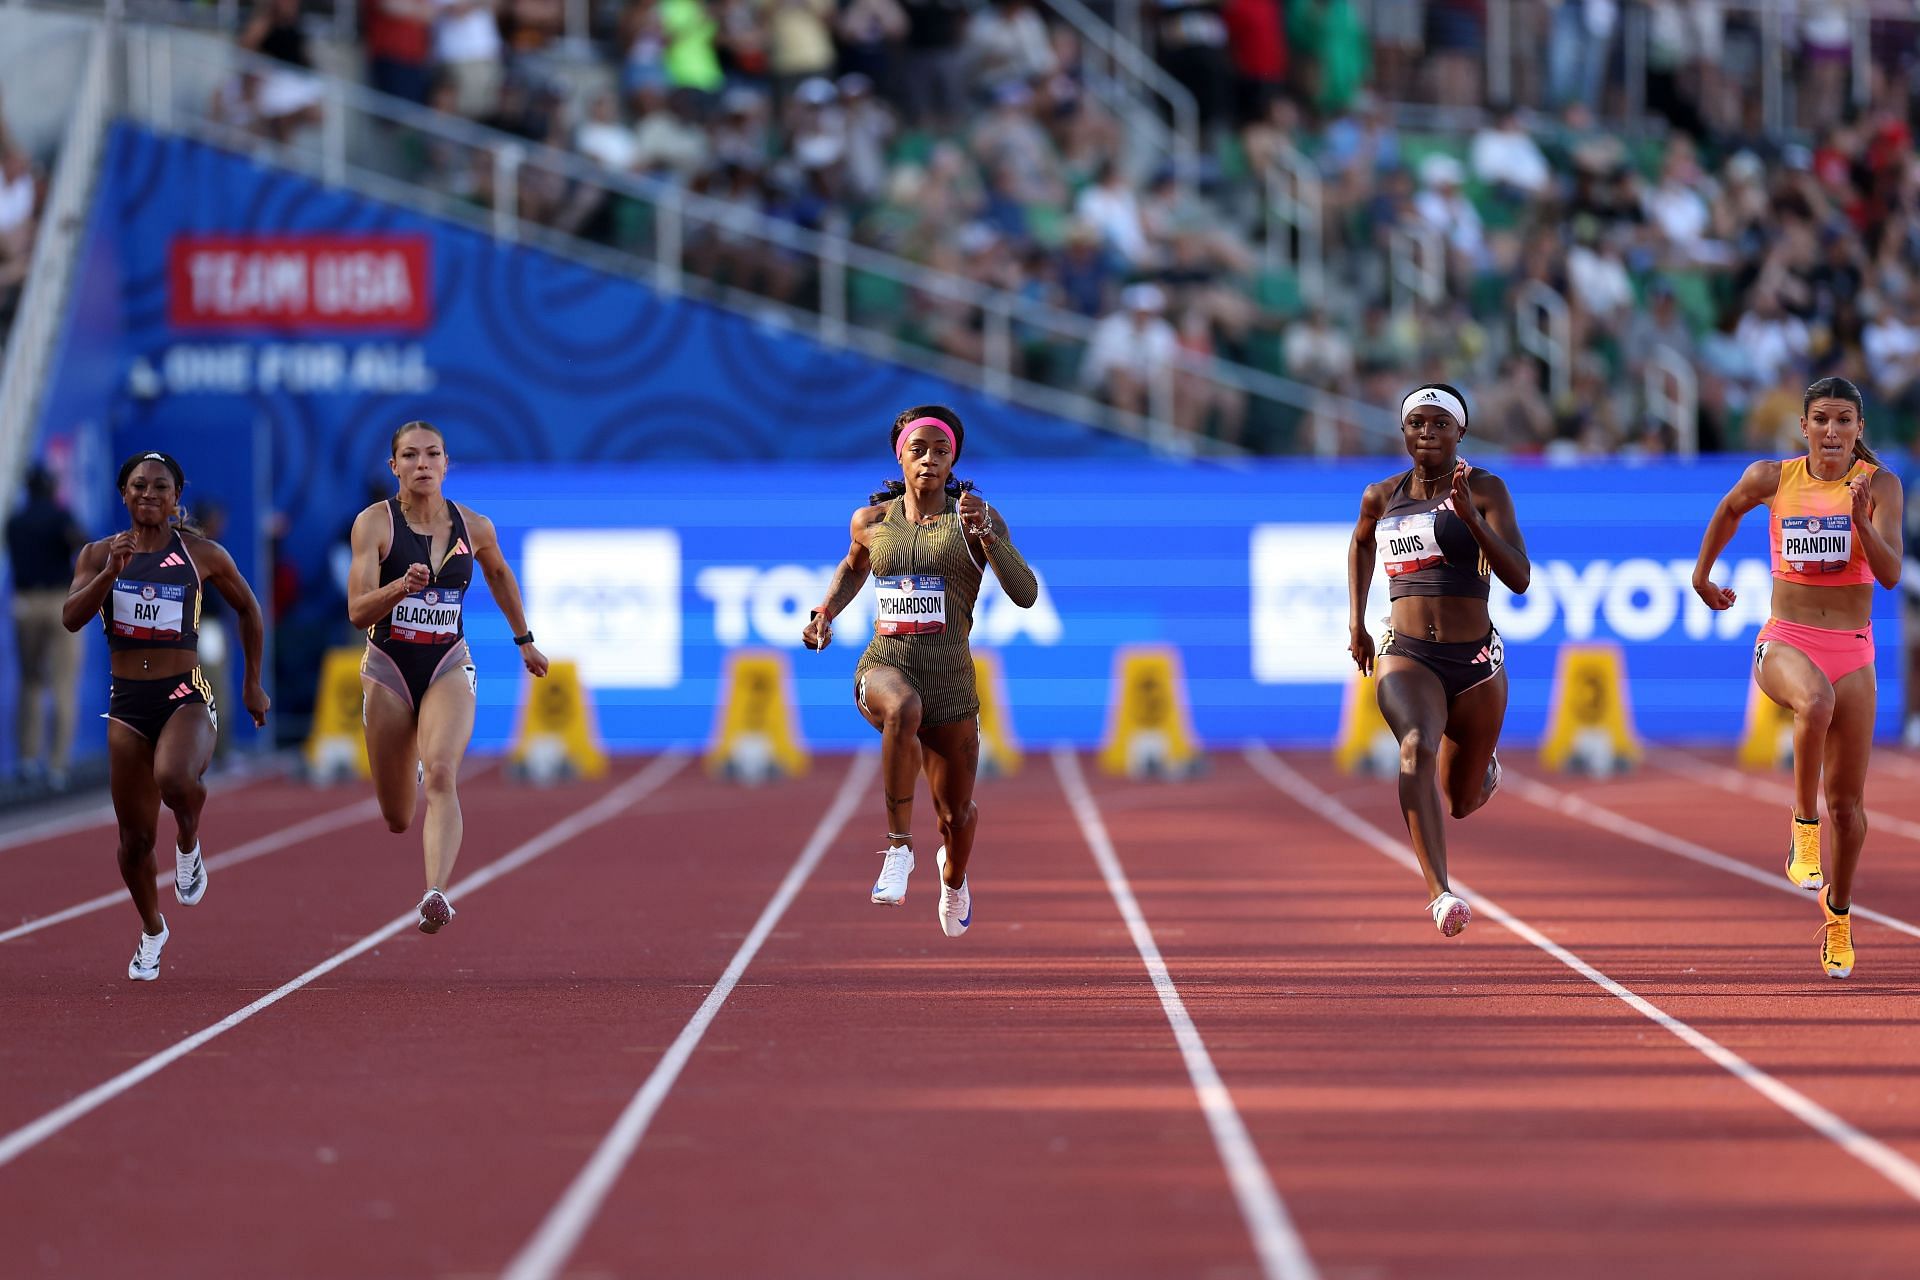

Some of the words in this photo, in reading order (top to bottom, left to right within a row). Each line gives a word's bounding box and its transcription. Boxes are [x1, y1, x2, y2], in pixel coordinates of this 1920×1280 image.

[190, 252, 306, 312] TEAM
[313, 252, 412, 312] USA
[163, 344, 249, 393] ONE
[258, 344, 347, 393] FOR
[1390, 535, 1424, 556] DAVIS
[1786, 536, 1846, 555] PRANDINI
[696, 565, 1063, 645] TOA
[880, 597, 942, 614] RICHARDSON
[1488, 558, 1773, 641] OYOTA
[134, 603, 161, 621] RAY
[396, 605, 458, 626] BLACKMON
